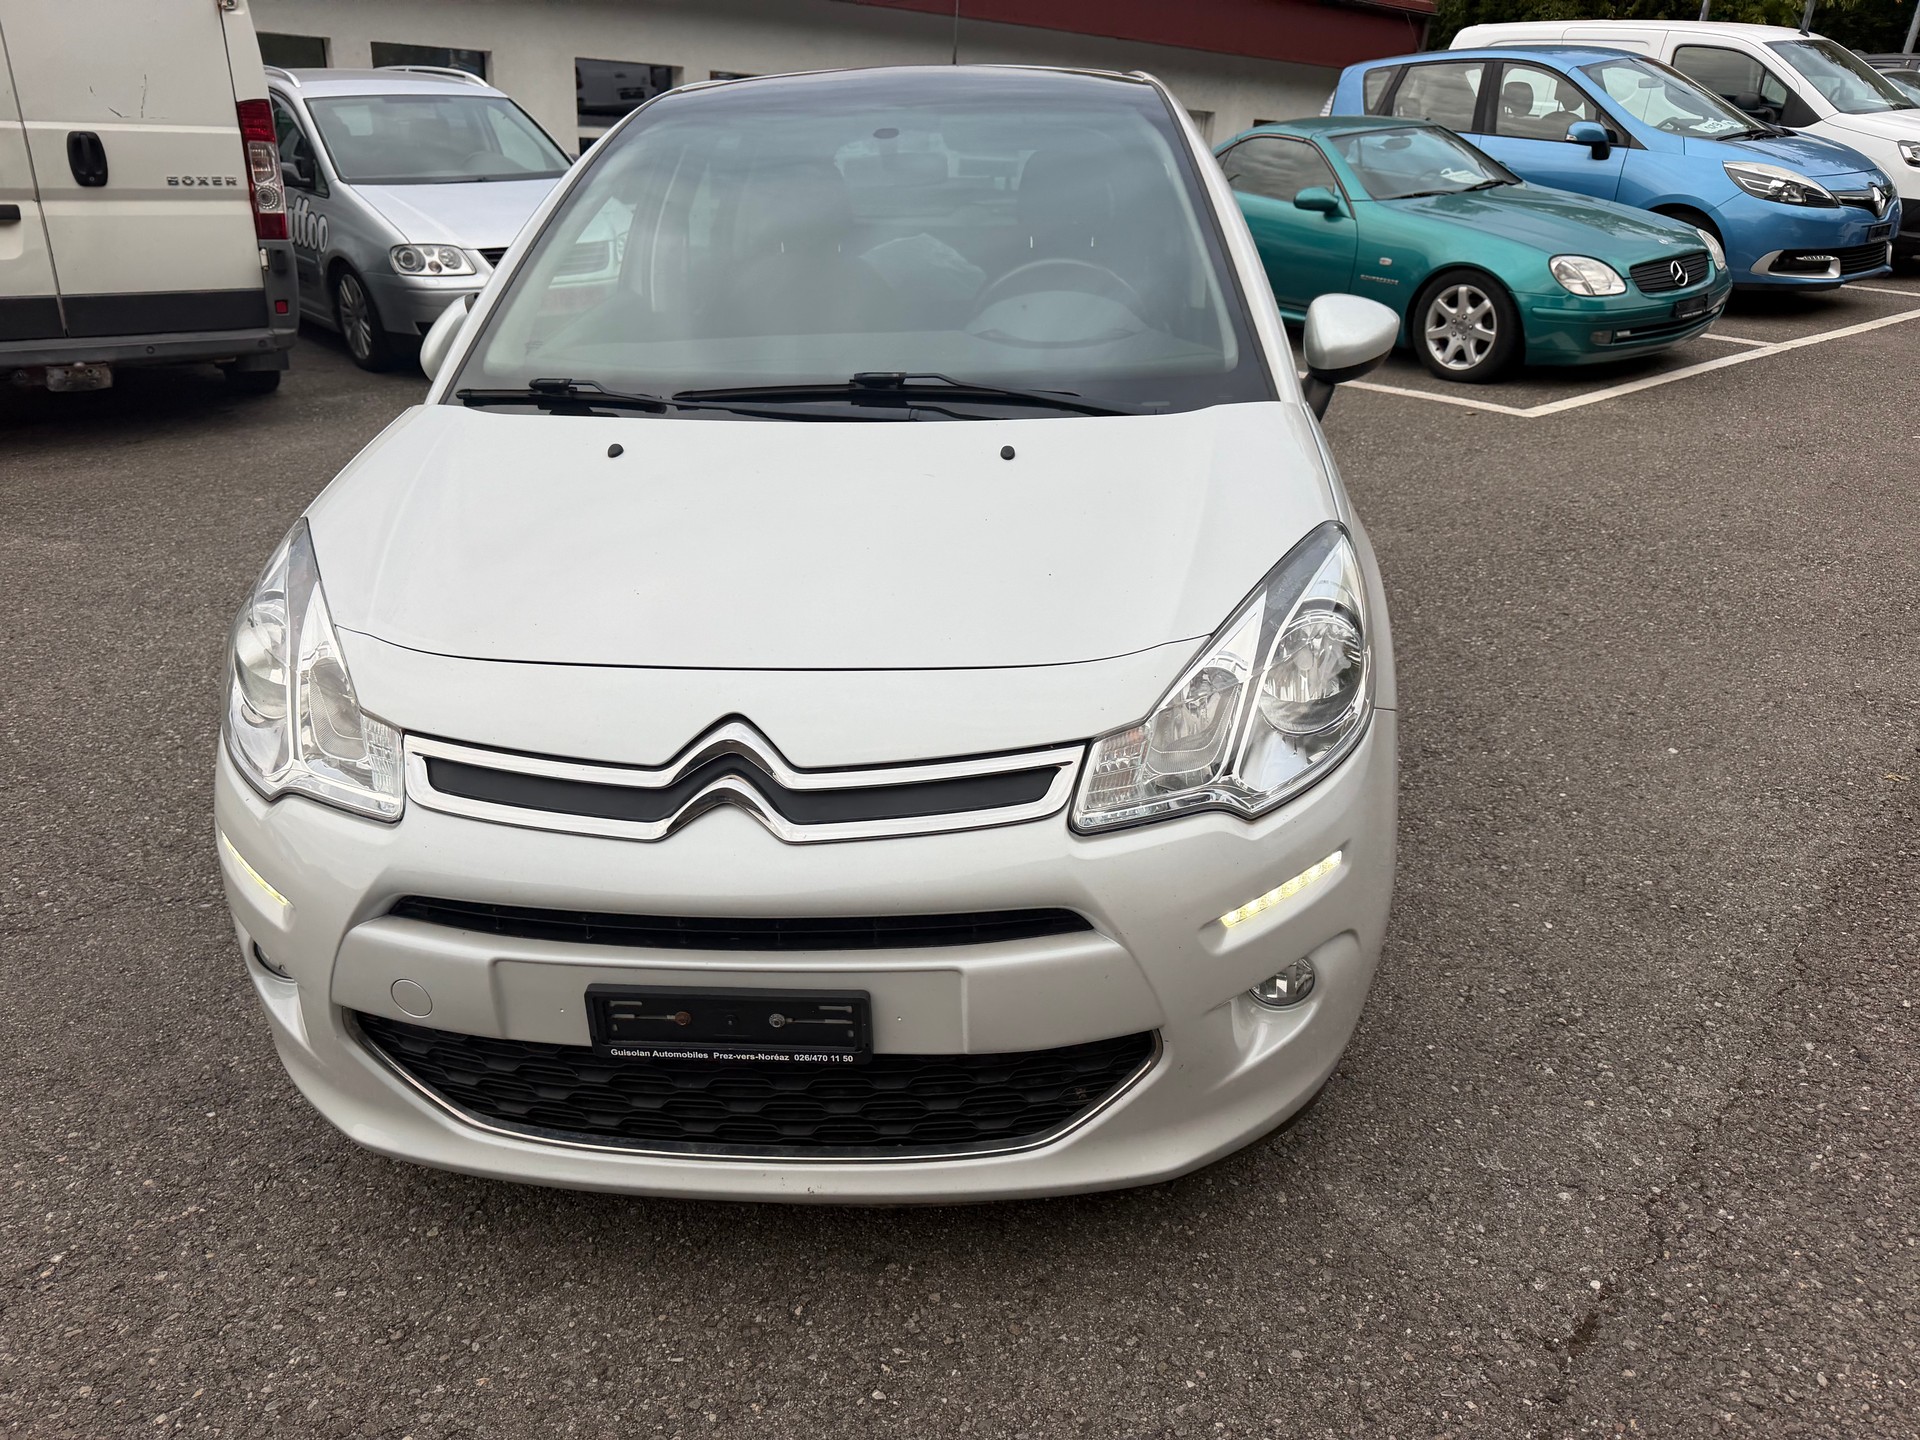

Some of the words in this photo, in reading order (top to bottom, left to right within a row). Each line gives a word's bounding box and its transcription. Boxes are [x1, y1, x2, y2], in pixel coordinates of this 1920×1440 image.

[166, 175, 238, 187] BOXER
[610, 1048, 651, 1057] Guisolan
[652, 1050, 709, 1059] Automobiles
[713, 1052, 790, 1061] Prez-vers-Noréaz
[793, 1054, 828, 1062] 026/470
